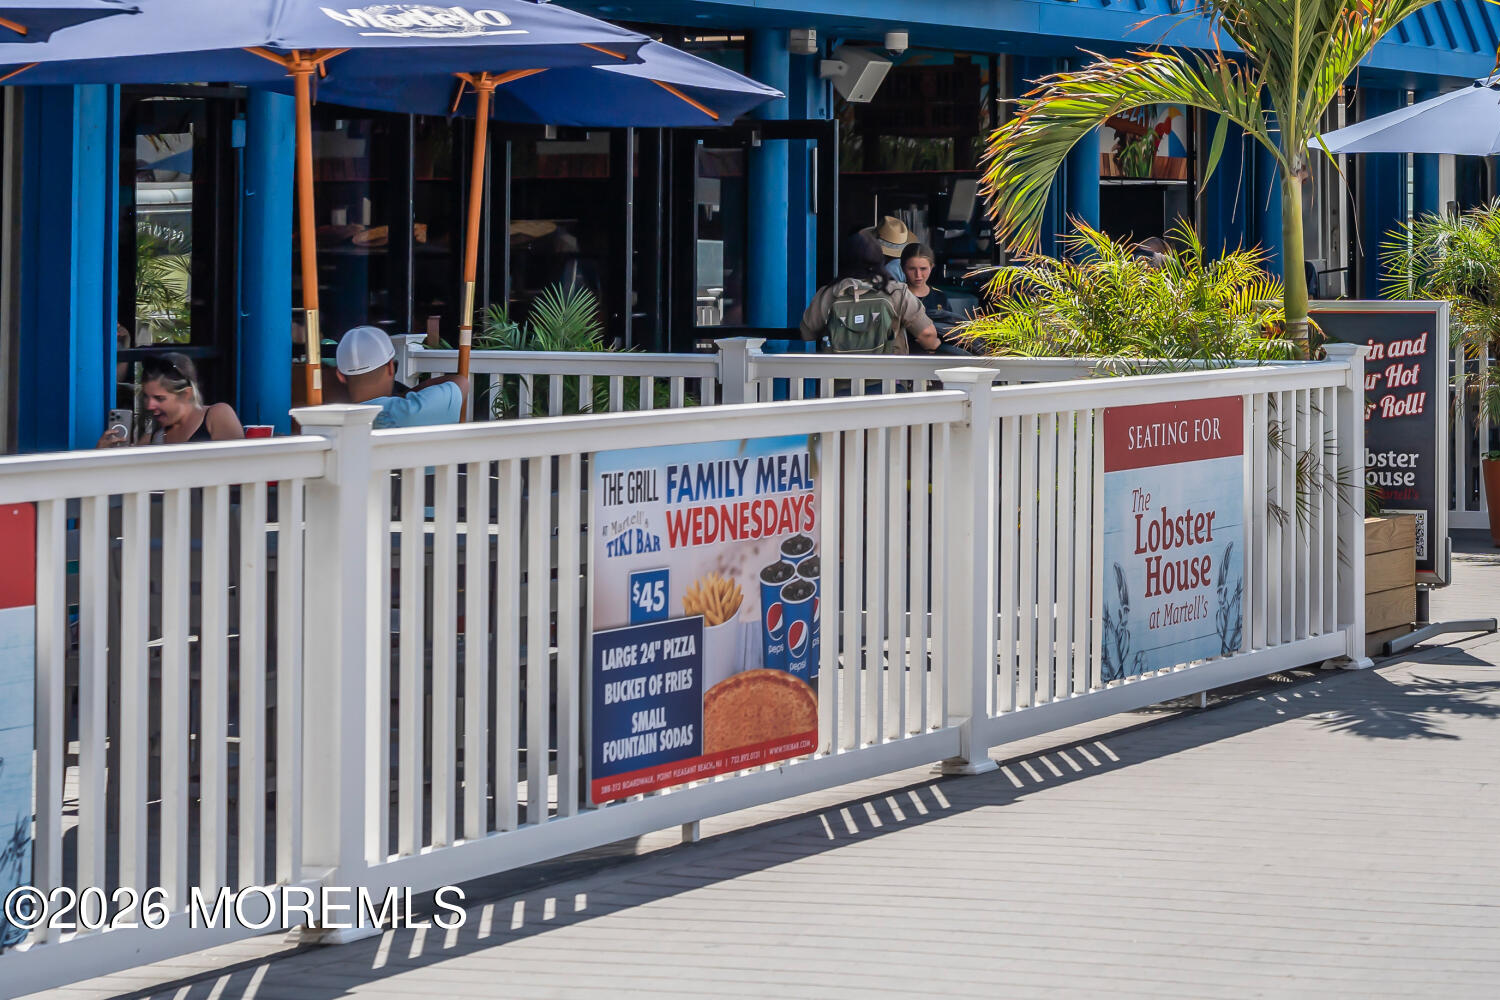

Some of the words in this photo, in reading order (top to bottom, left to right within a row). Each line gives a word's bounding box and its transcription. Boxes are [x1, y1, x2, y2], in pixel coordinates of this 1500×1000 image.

[318, 5, 512, 29] Modelo
[1387, 332, 1427, 357] and
[1385, 363, 1420, 388] Hot
[1380, 392, 1426, 418] Roll!
[1128, 420, 1188, 450] SEATING
[1194, 417, 1221, 442] FOR
[1365, 448, 1419, 467] bster
[601, 472, 624, 506] THE
[627, 469, 659, 504] GRILL
[667, 459, 749, 504] FAMILY
[756, 453, 813, 494] MEAL
[1366, 470, 1415, 486] ouse
[1132, 488, 1151, 512] The
[665, 493, 815, 548] WEDNESDAYS
[1134, 507, 1216, 555] Lobster
[606, 529, 632, 558] TIKI
[636, 528, 661, 554] BAR
[1144, 554, 1212, 598] House
[633, 580, 665, 612] $45
[1149, 606, 1160, 629] at
[1162, 596, 1208, 627] Martell's
[602, 647, 637, 671] LARGE
[640, 640, 660, 665] 24"
[663, 635, 696, 660] PIZZA
[790, 659, 807, 672] pepsi
[604, 677, 646, 704] BUCKET
[648, 674, 662, 695] OF
[665, 668, 693, 692] FRIES
[631, 707, 666, 734] SMALL
[603, 734, 657, 764] FOUNTAIN
[660, 724, 693, 751] SODAS
